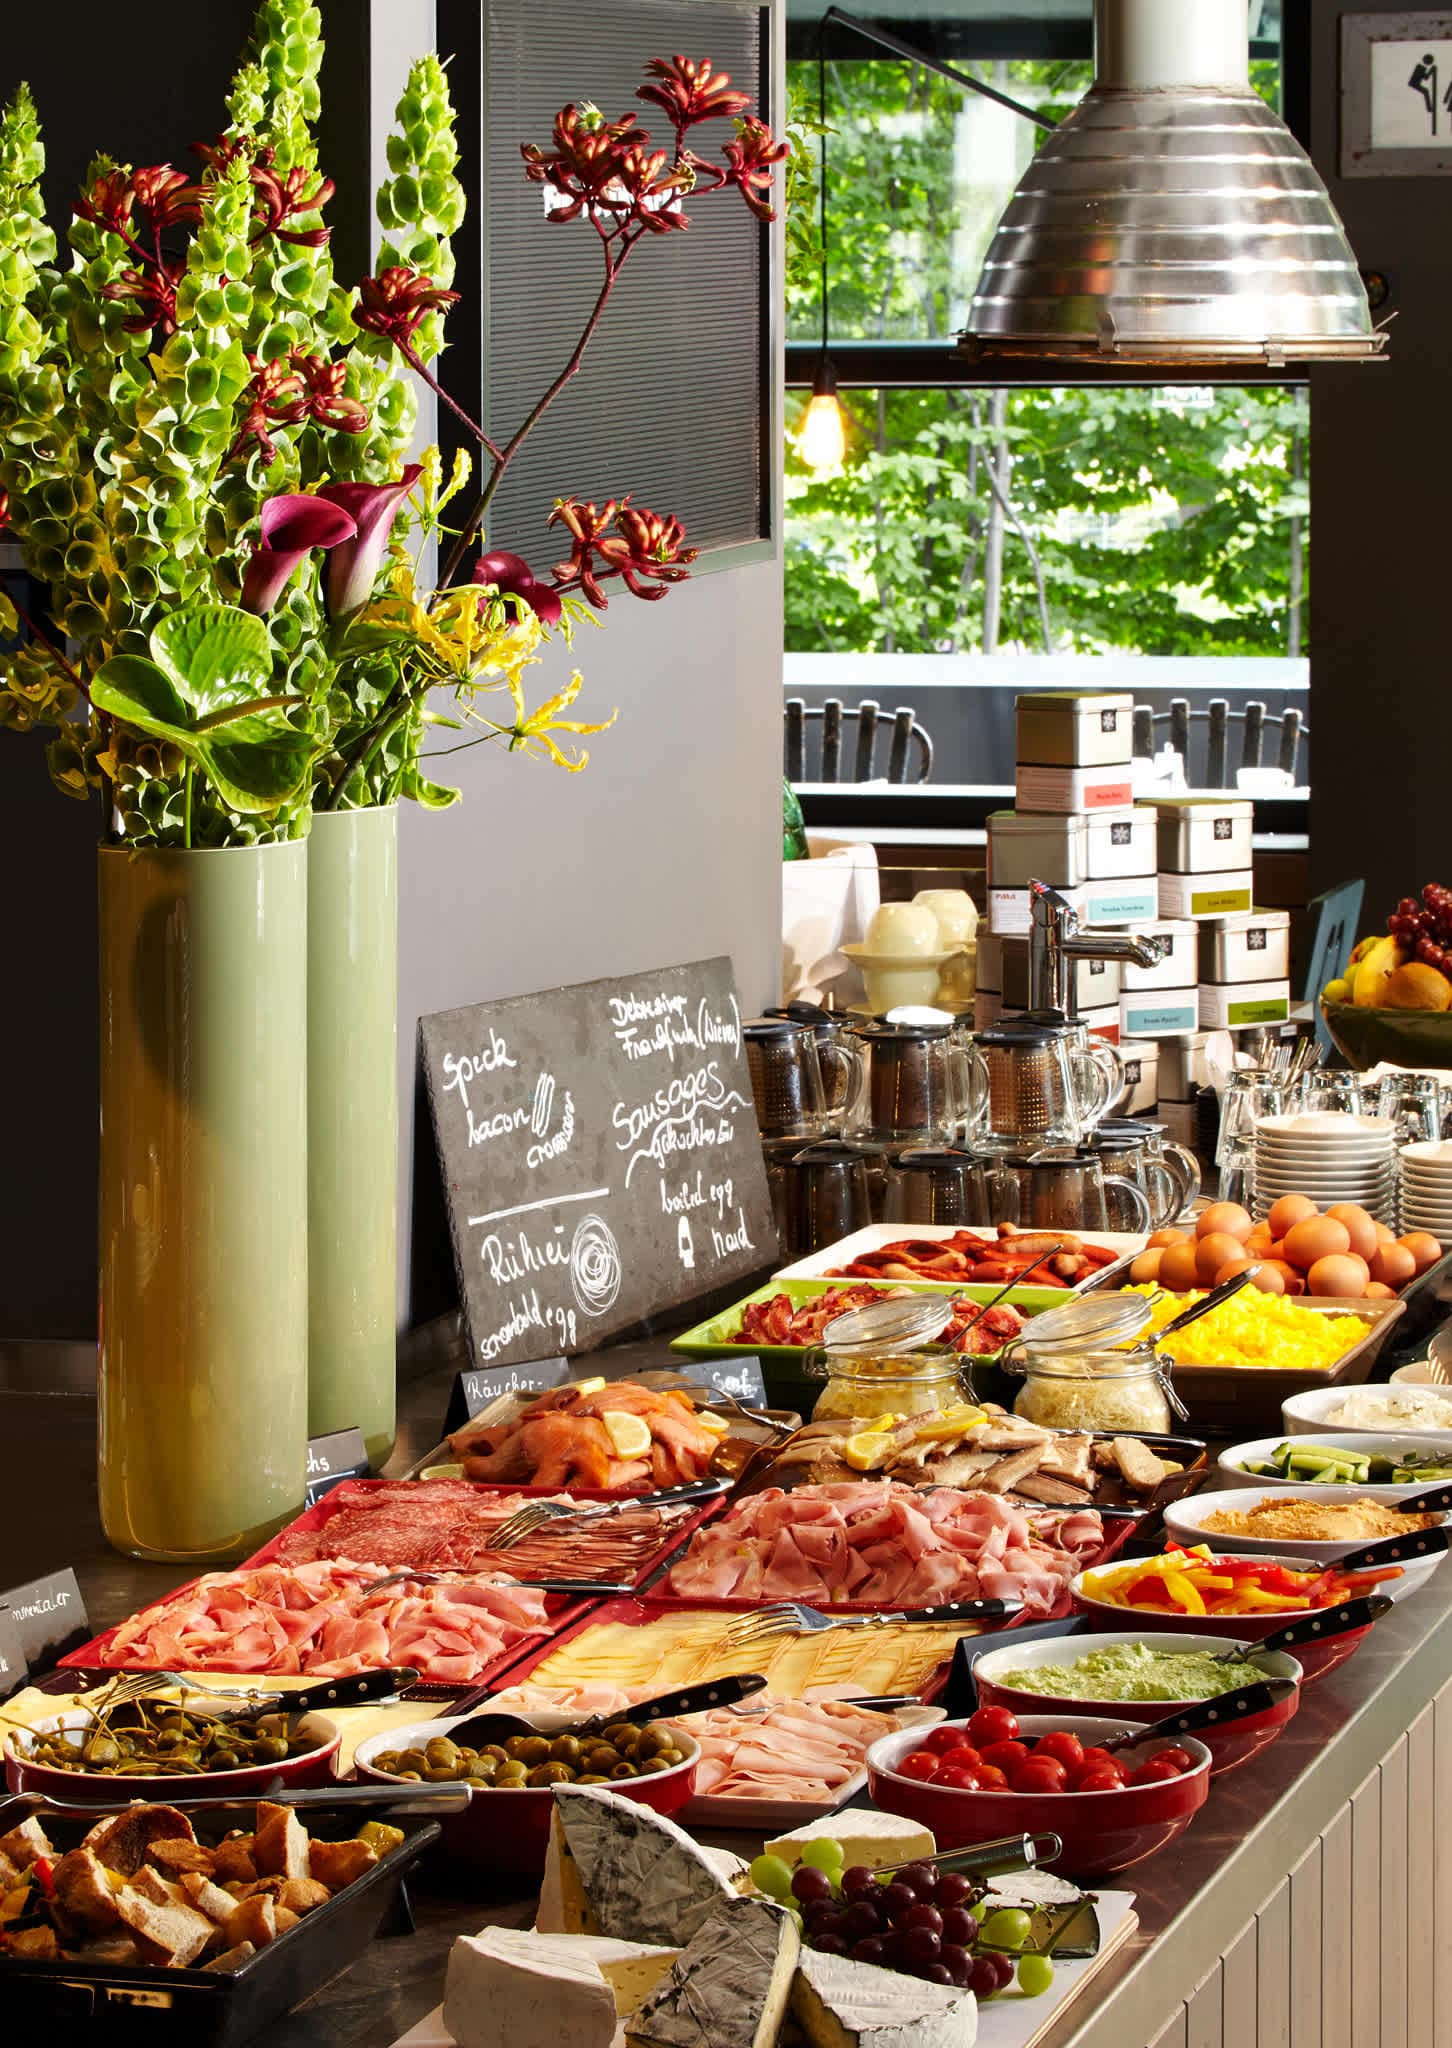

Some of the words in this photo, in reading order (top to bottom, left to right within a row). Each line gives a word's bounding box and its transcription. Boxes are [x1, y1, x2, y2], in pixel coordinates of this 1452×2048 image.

[442, 1027, 518, 1109] Speck
[466, 1108, 530, 1148] bacon
[612, 1061, 725, 1150] Sausages
[660, 1170, 707, 1214] boiled
[710, 1178, 733, 1220] egg
